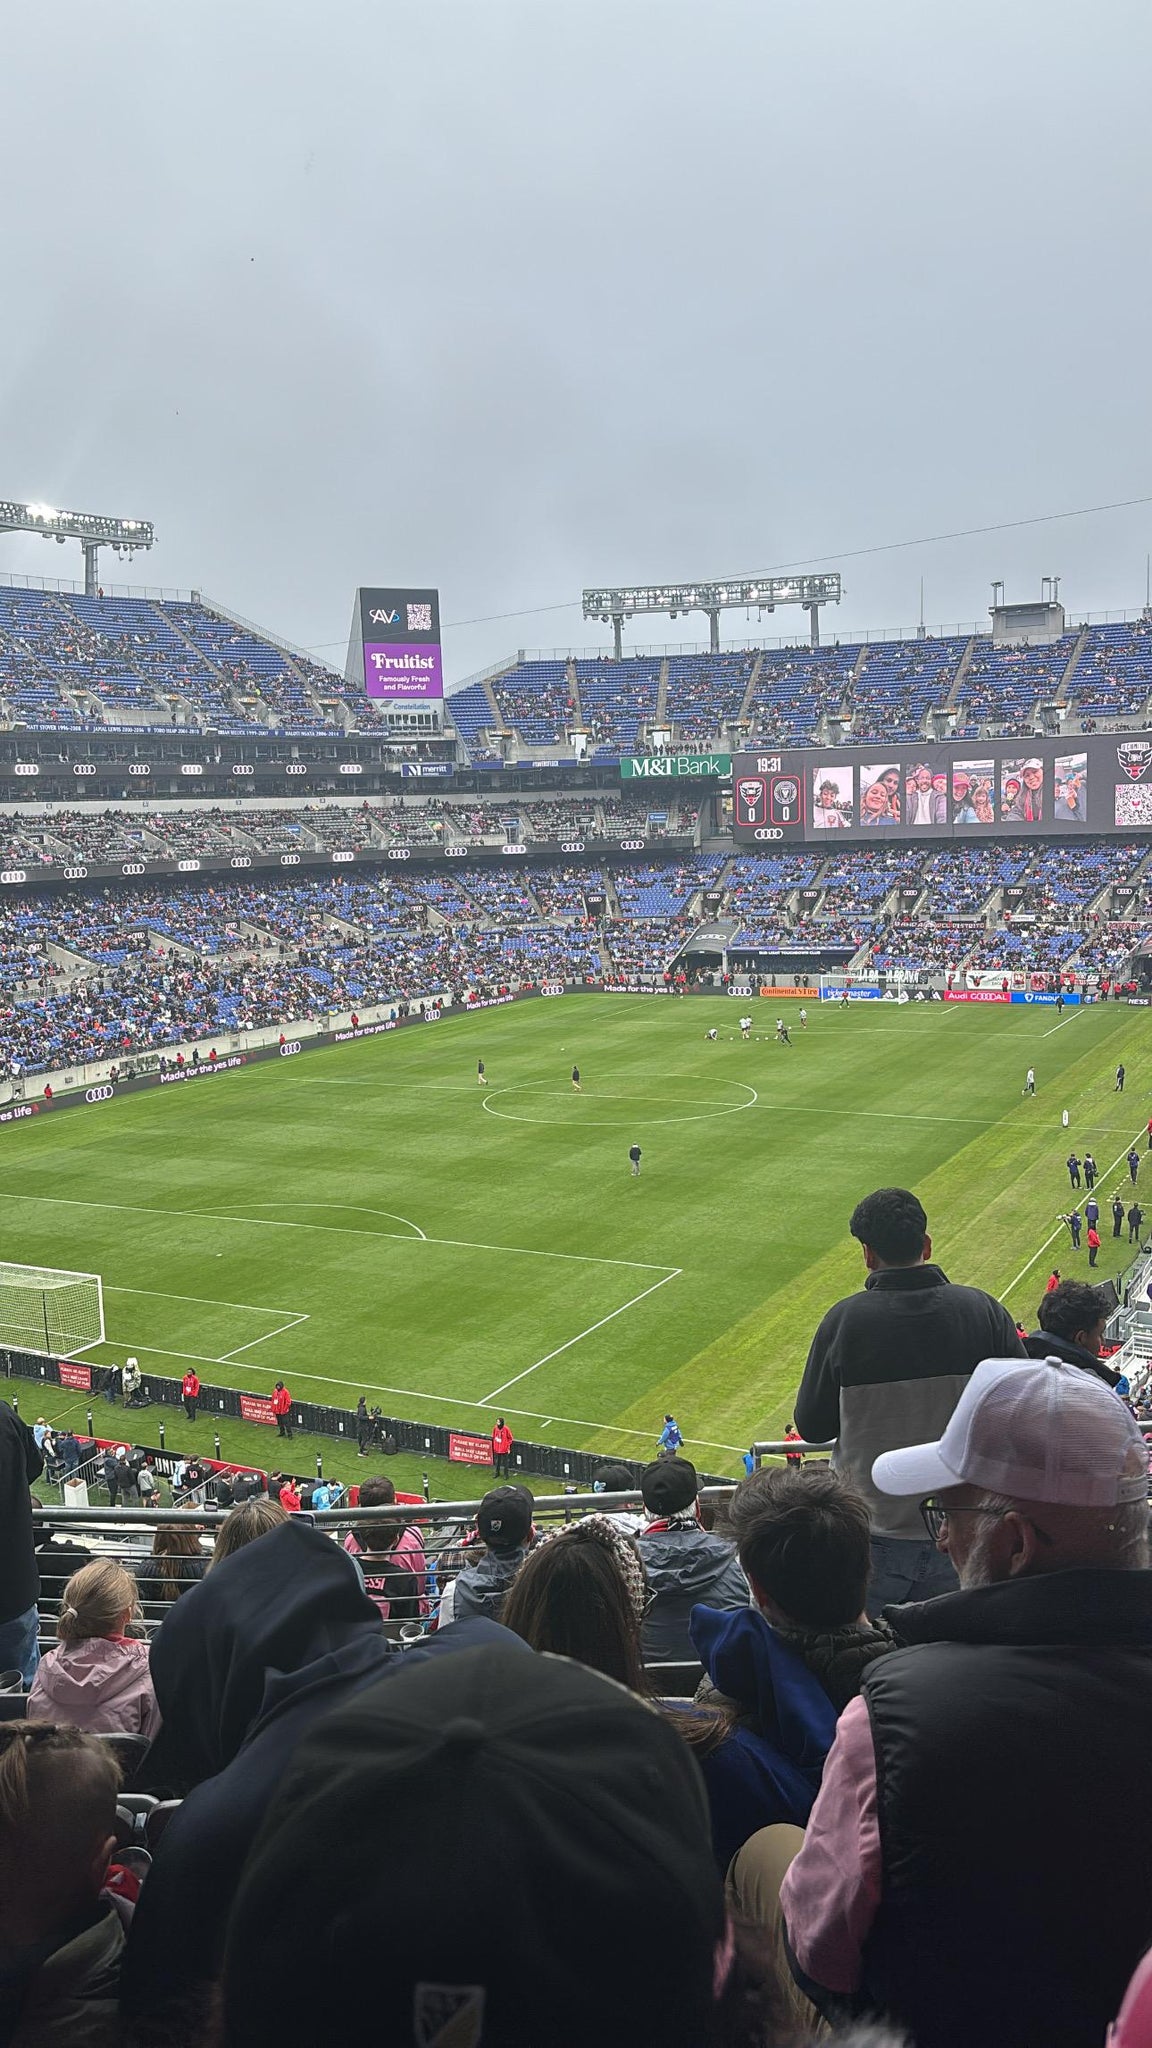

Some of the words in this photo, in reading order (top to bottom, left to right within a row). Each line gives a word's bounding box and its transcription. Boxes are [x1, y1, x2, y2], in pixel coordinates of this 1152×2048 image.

[371, 653, 435, 669] Fruitist
[379, 676, 410, 684] Famously
[422, 765, 447, 773] merritt
[631, 757, 676, 777] M&T
[677, 756, 720, 775] Bank
[757, 757, 782, 773] 19:31
[748, 807, 755, 822] 0
[783, 806, 790, 821] 0
[604, 984, 626, 993] Made
[628, 985, 640, 993] for
[640, 985, 653, 993] the
[654, 987, 668, 995] yes
[761, 987, 797, 996] Continental
[948, 992, 968, 1000] Audi
[467, 1002, 480, 1010] Made
[481, 999, 489, 1007] for
[496, 997, 505, 1005] yes
[335, 1031, 354, 1041] Made
[354, 1029, 364, 1037] for
[364, 1026, 374, 1035] the
[374, 1024, 385, 1034] yes
[385, 1021, 396, 1029] life
[160, 1071, 185, 1083] Made
[186, 1067, 198, 1077] for
[199, 1064, 213, 1074] the
[213, 1061, 228, 1073] yes
[227, 1057, 242, 1067] life
[0, 1111, 13, 1121] es
[14, 1106, 32, 1118] life
[189, 1470, 198, 1479] 10
